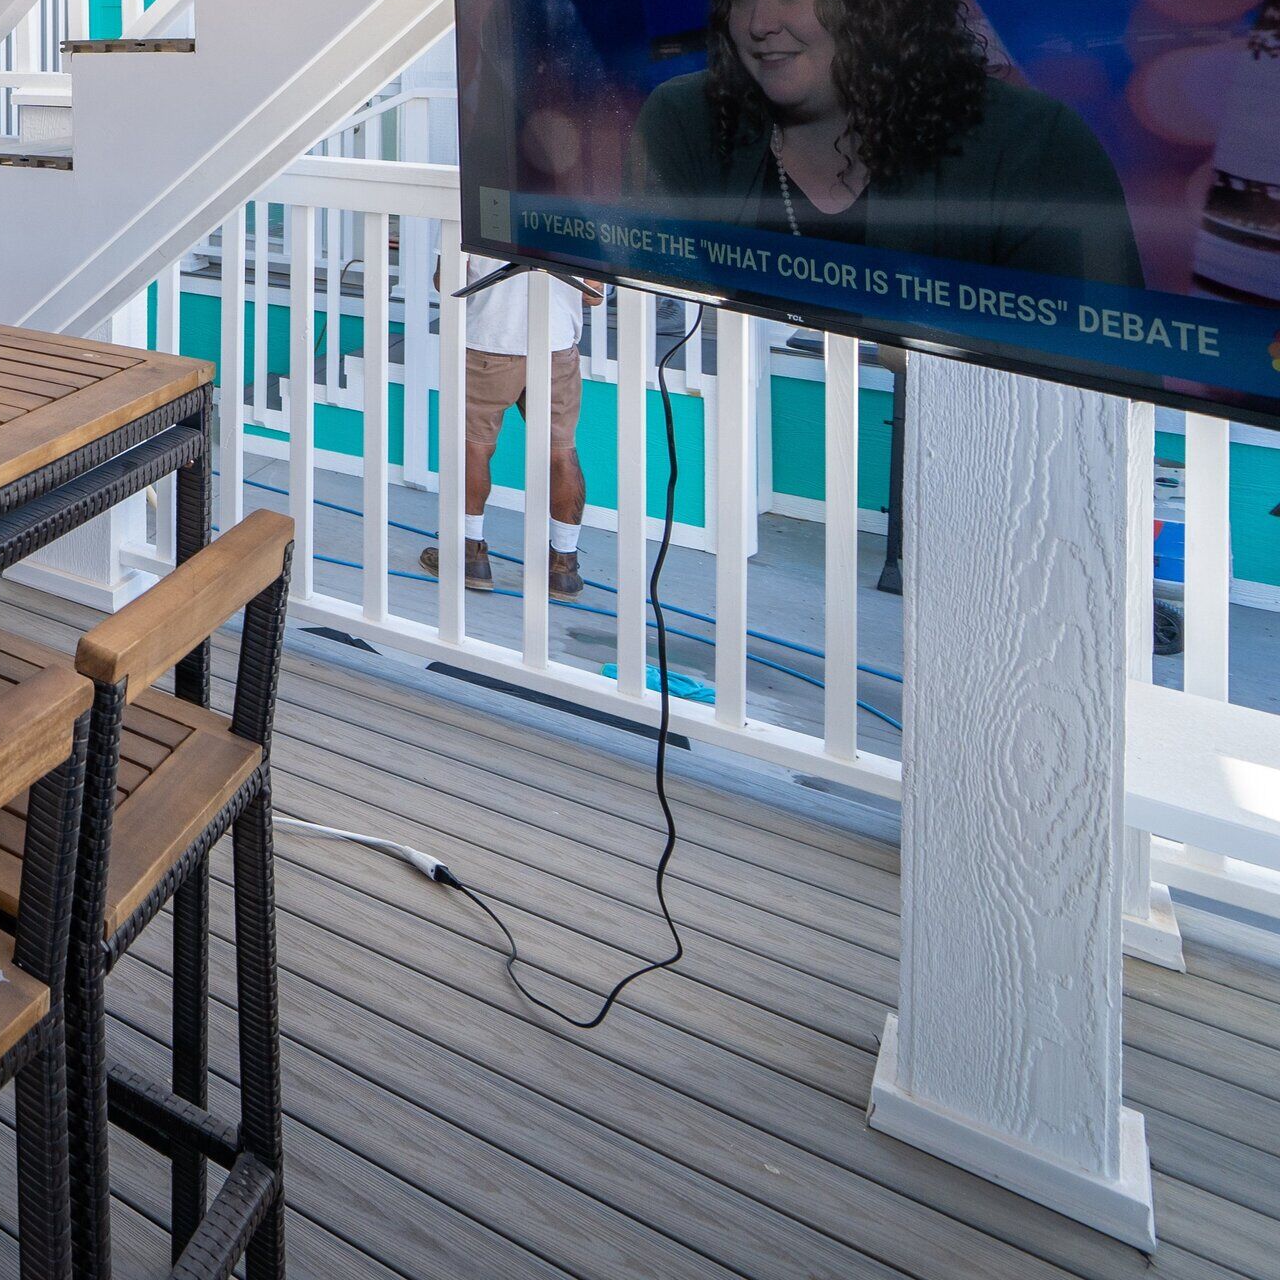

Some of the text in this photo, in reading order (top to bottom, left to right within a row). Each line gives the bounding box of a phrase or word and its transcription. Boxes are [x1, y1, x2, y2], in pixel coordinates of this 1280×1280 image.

[521, 210, 1220, 358] 10 YEARS SINCE THE "WHAT COLOR IS THE DRESS" DEBATE
[786, 313, 804, 323] TCL
